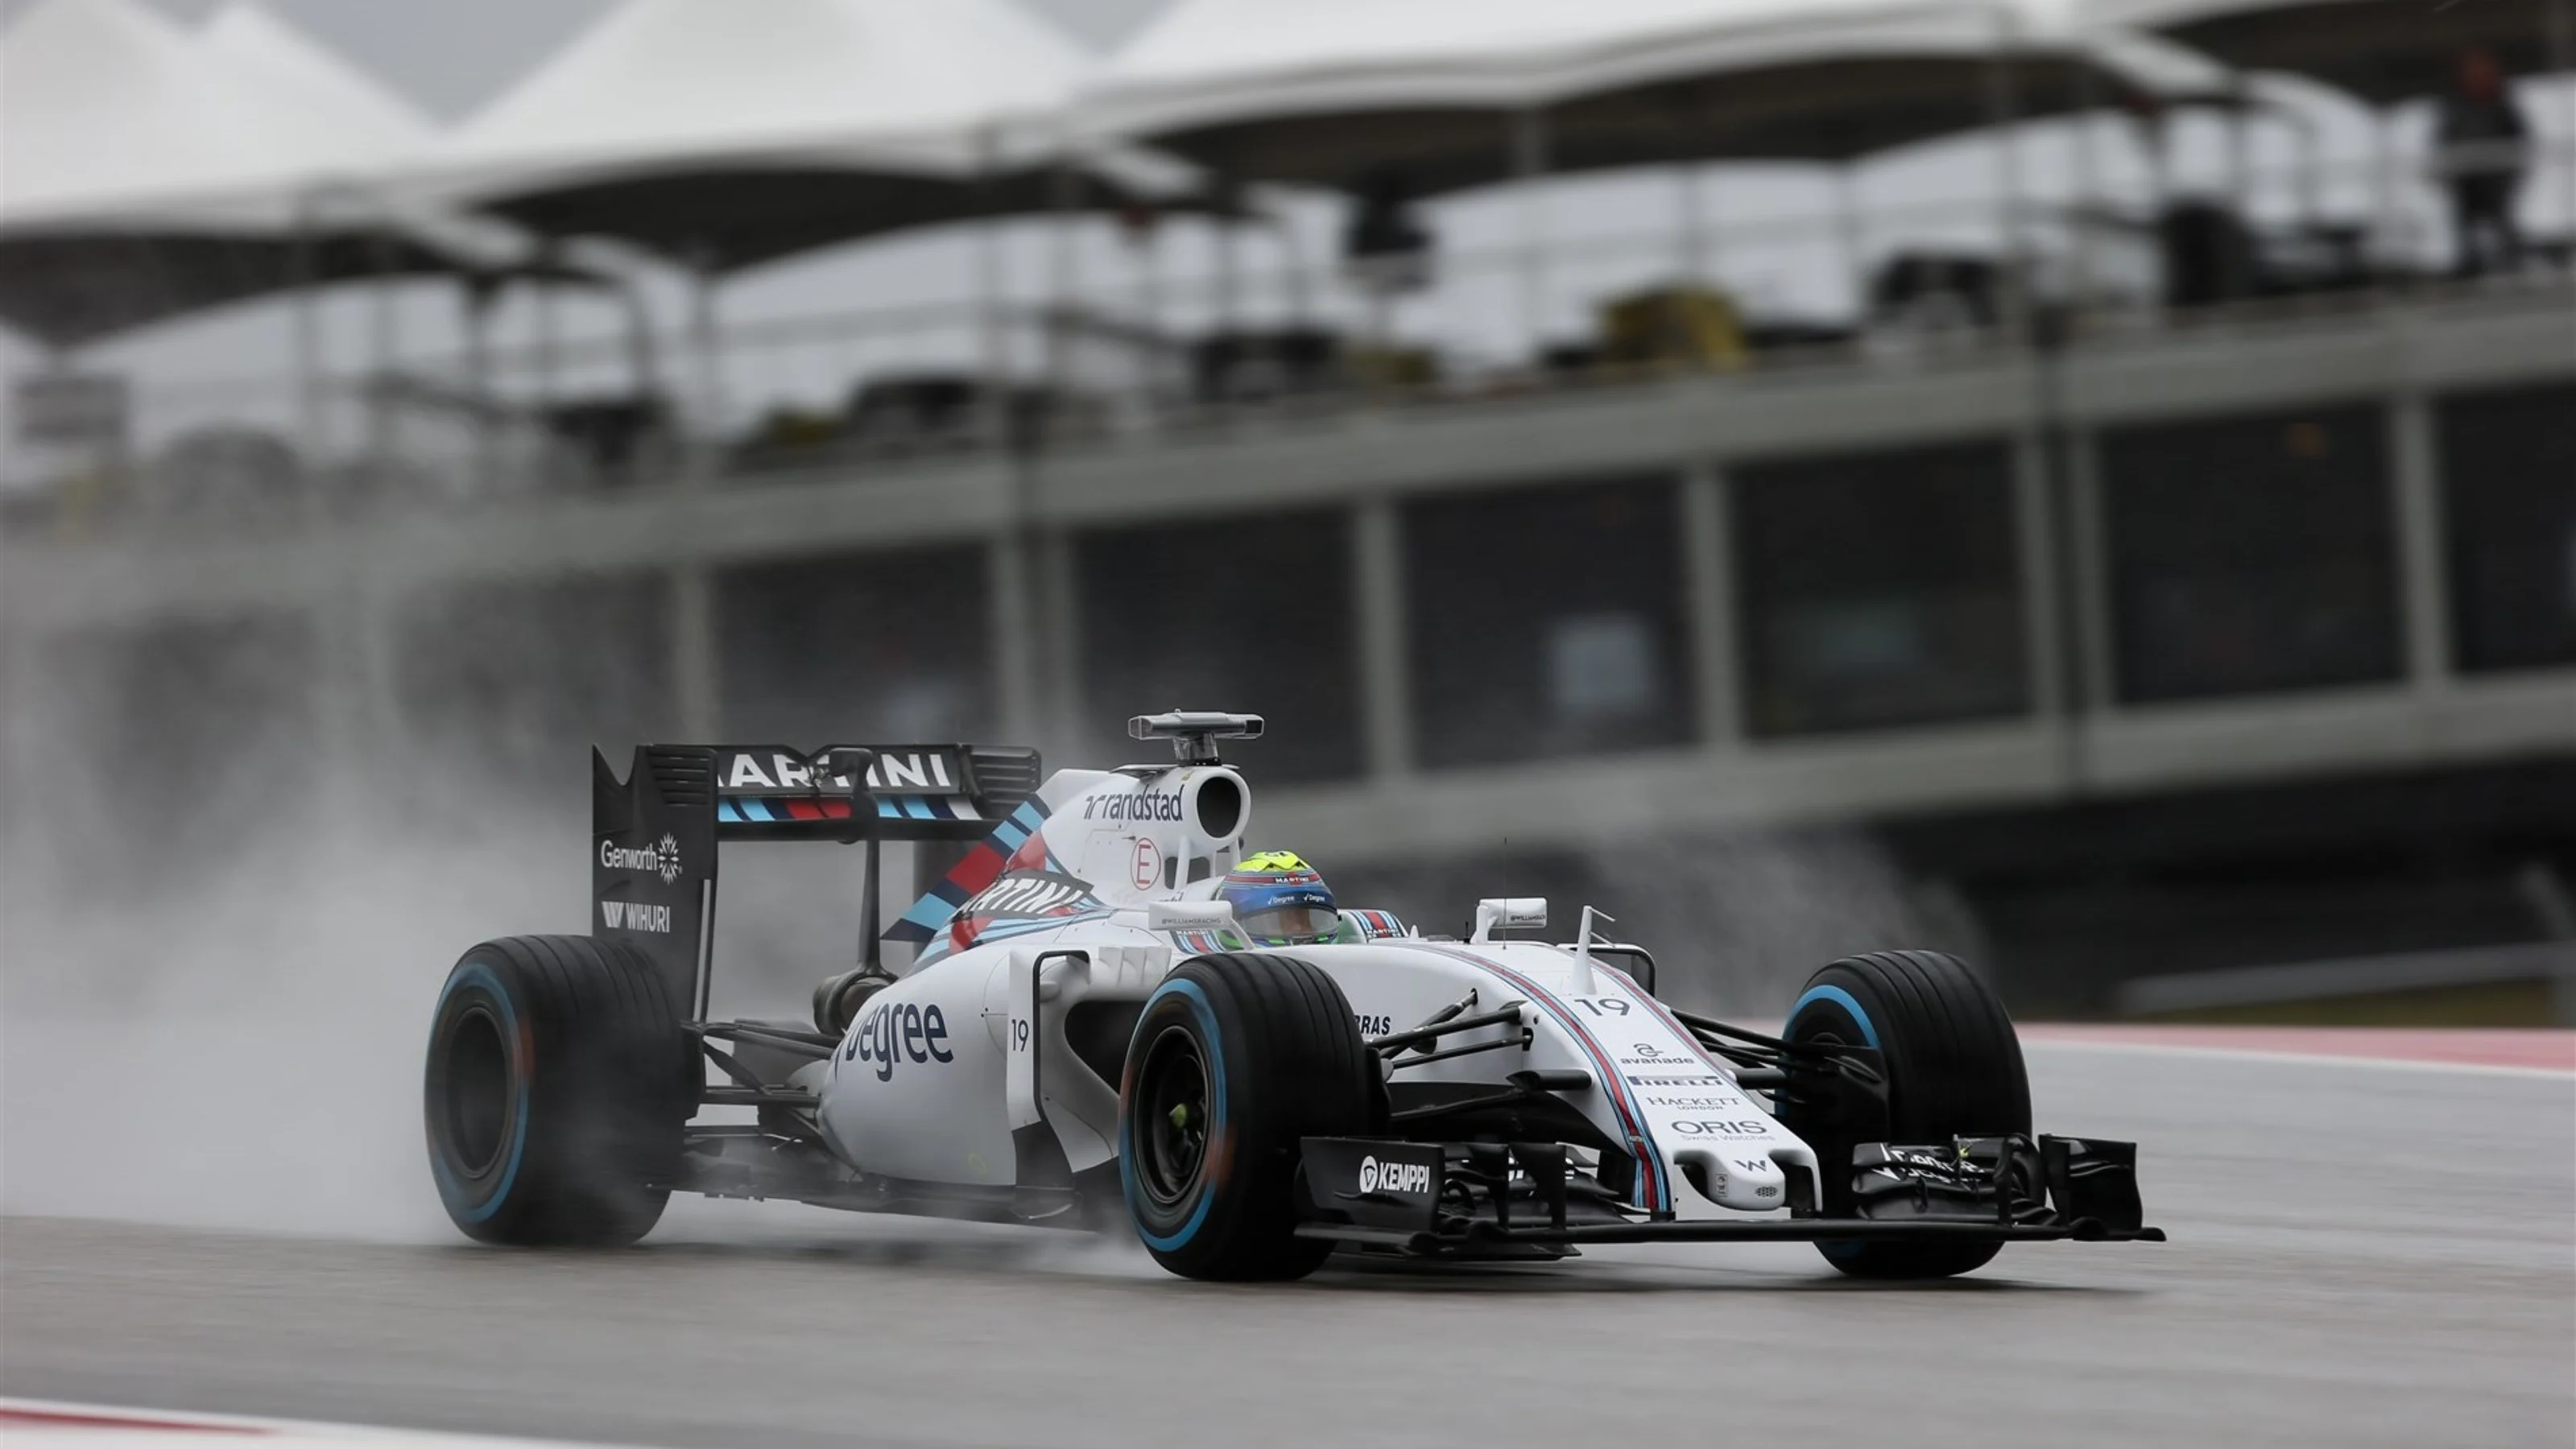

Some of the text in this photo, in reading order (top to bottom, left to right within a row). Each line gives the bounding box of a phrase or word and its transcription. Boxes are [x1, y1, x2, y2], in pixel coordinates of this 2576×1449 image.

[1102, 784, 1185, 821] randstad
[601, 840, 657, 871] Genworth
[1136, 844, 1152, 885] E
[626, 902, 670, 933] WIHURI
[1574, 998, 1631, 1017] 19
[1011, 1019, 1029, 1052] 19
[1620, 1056, 1695, 1065] avanade
[1627, 1075, 1724, 1086] PIRELLI
[1646, 1096, 1742, 1107] HACKETT
[1671, 1120, 1768, 1135] ORIS
[1377, 1162, 1430, 1194] KEMPPI
